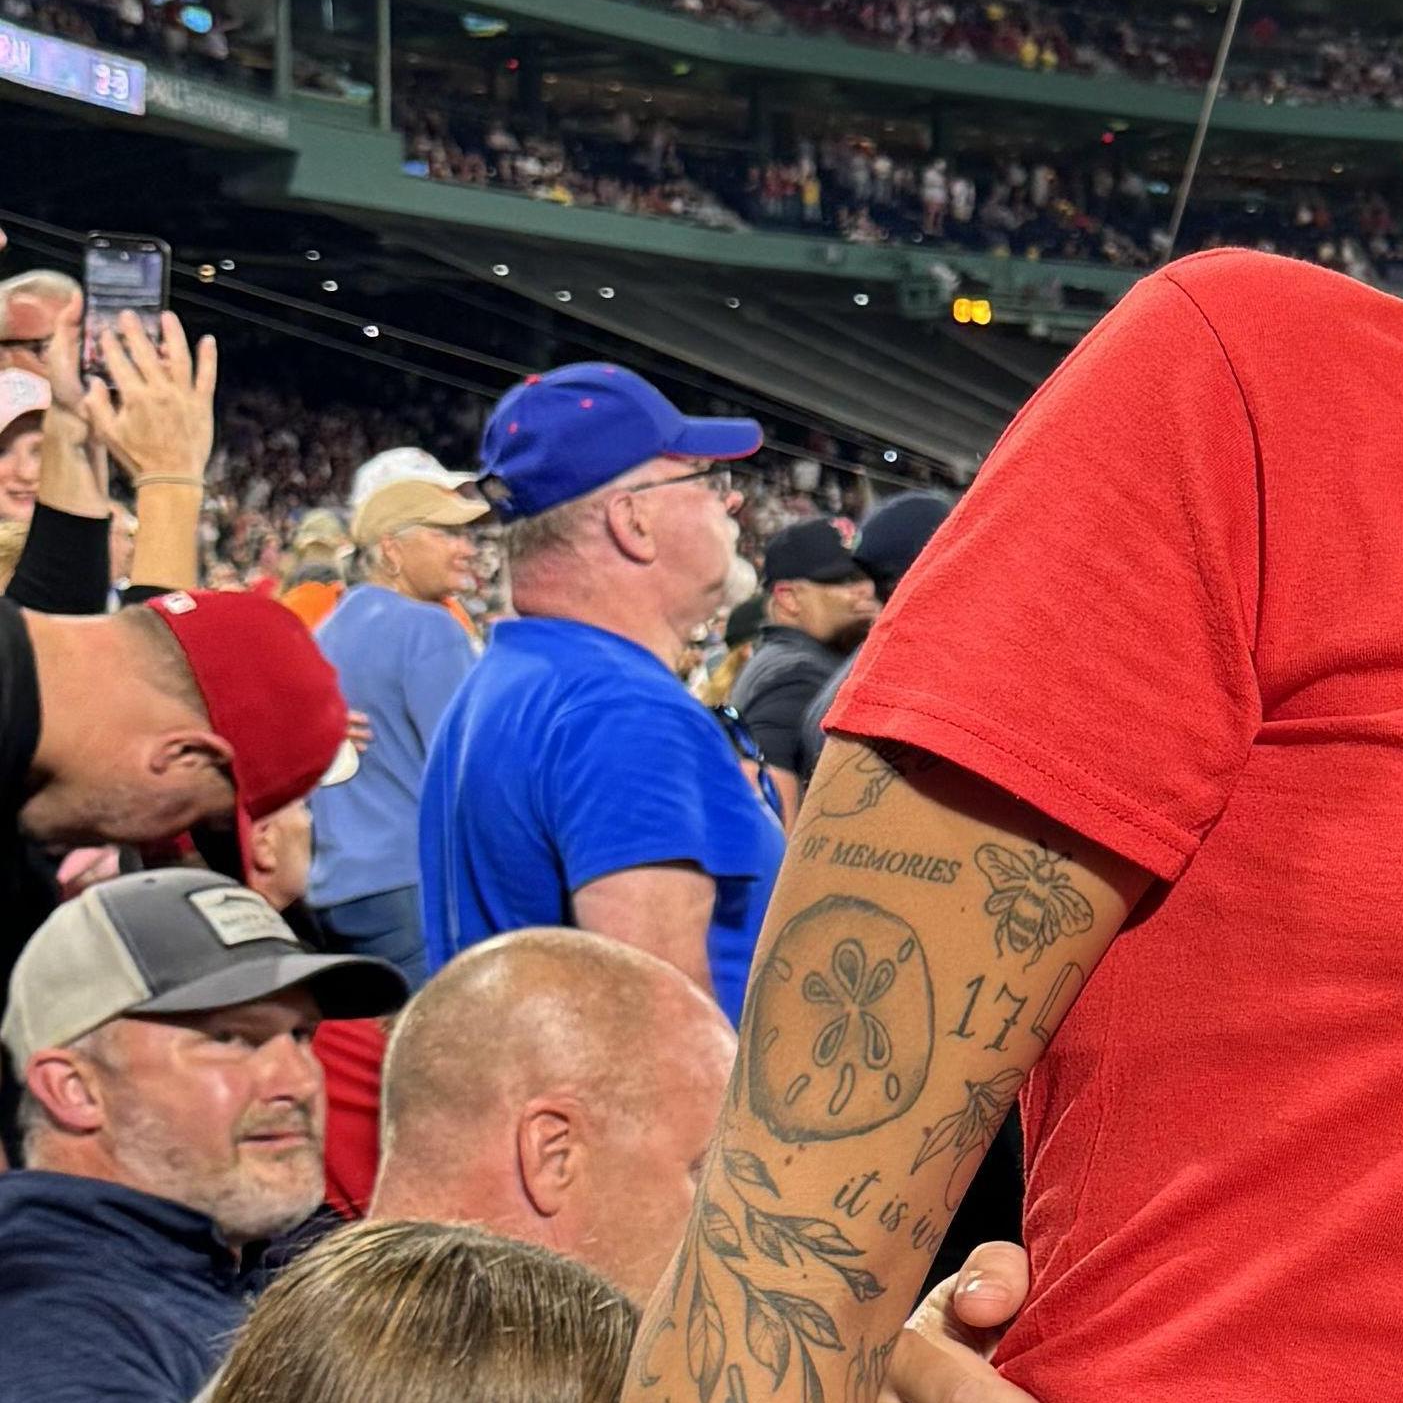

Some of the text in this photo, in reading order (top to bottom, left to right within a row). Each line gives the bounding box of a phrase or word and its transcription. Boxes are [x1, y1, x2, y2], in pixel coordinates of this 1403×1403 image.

[802, 834, 963, 885] OF MEMORIES
[945, 973, 1028, 1053] 17
[833, 1170, 881, 1219] it
